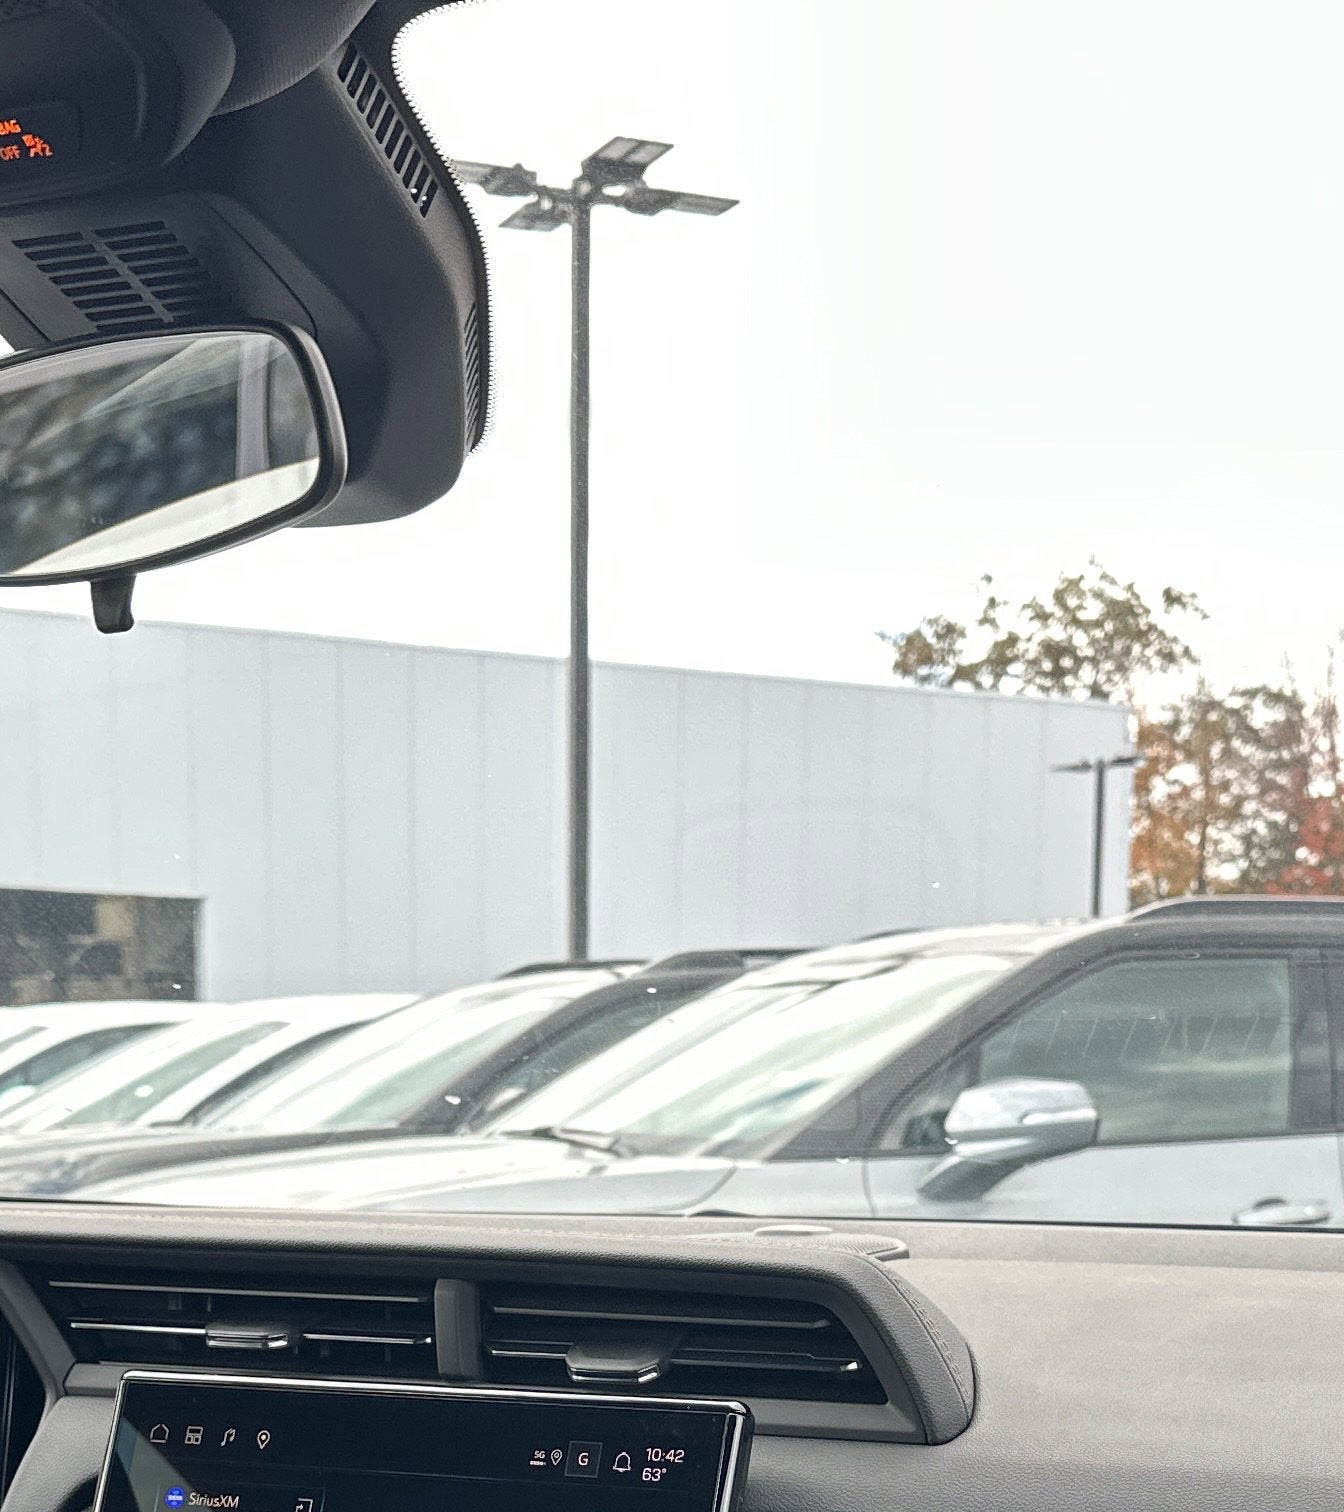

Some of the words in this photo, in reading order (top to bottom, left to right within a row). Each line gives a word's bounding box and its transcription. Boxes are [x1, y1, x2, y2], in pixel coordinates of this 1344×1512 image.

[578, 1452, 589, 1466] G
[645, 1447, 685, 1464] 10:42
[642, 1467, 668, 1482] 63°
[188, 1491, 240, 1509] SiriusXM
